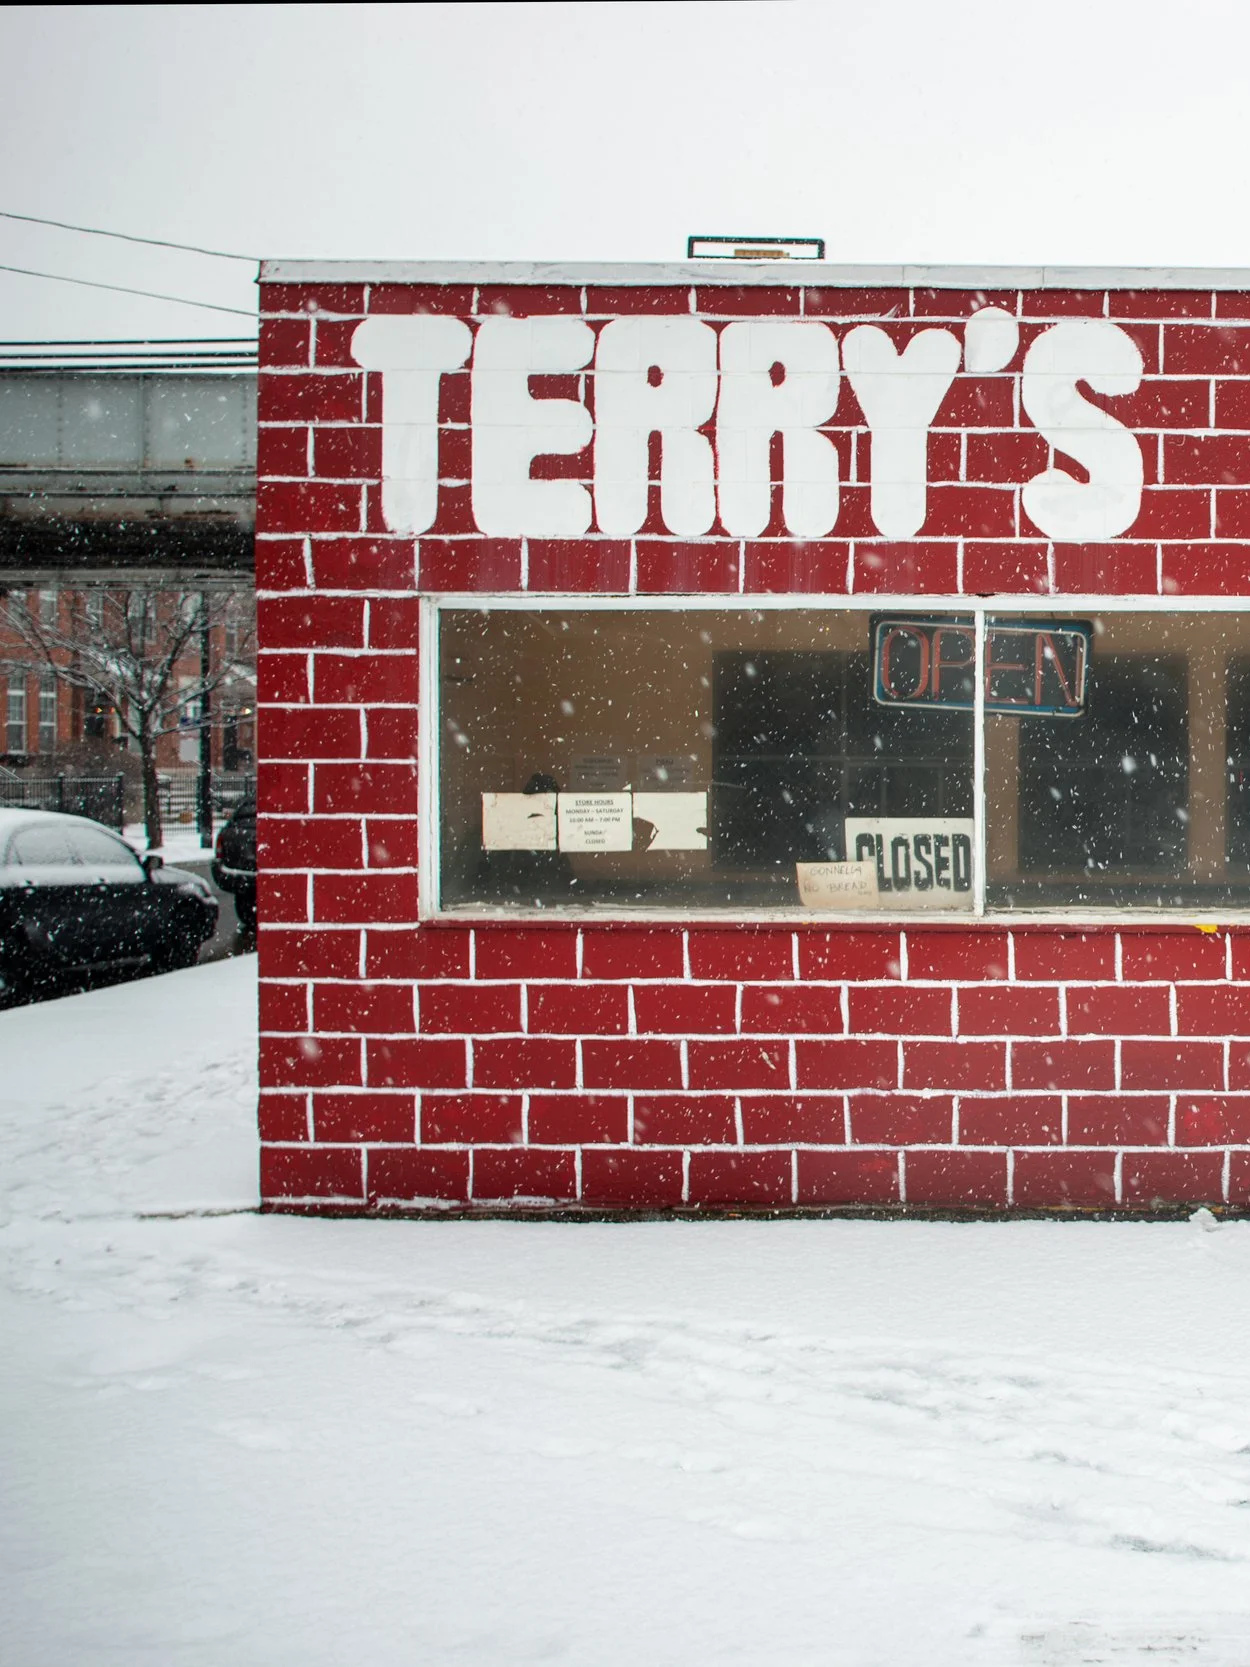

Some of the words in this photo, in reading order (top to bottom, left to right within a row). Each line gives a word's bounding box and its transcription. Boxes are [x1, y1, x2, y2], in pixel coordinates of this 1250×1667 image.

[350, 306, 1144, 540] TERRY'S
[881, 625, 1082, 707] OPEN
[855, 832, 972, 893] CLOSED
